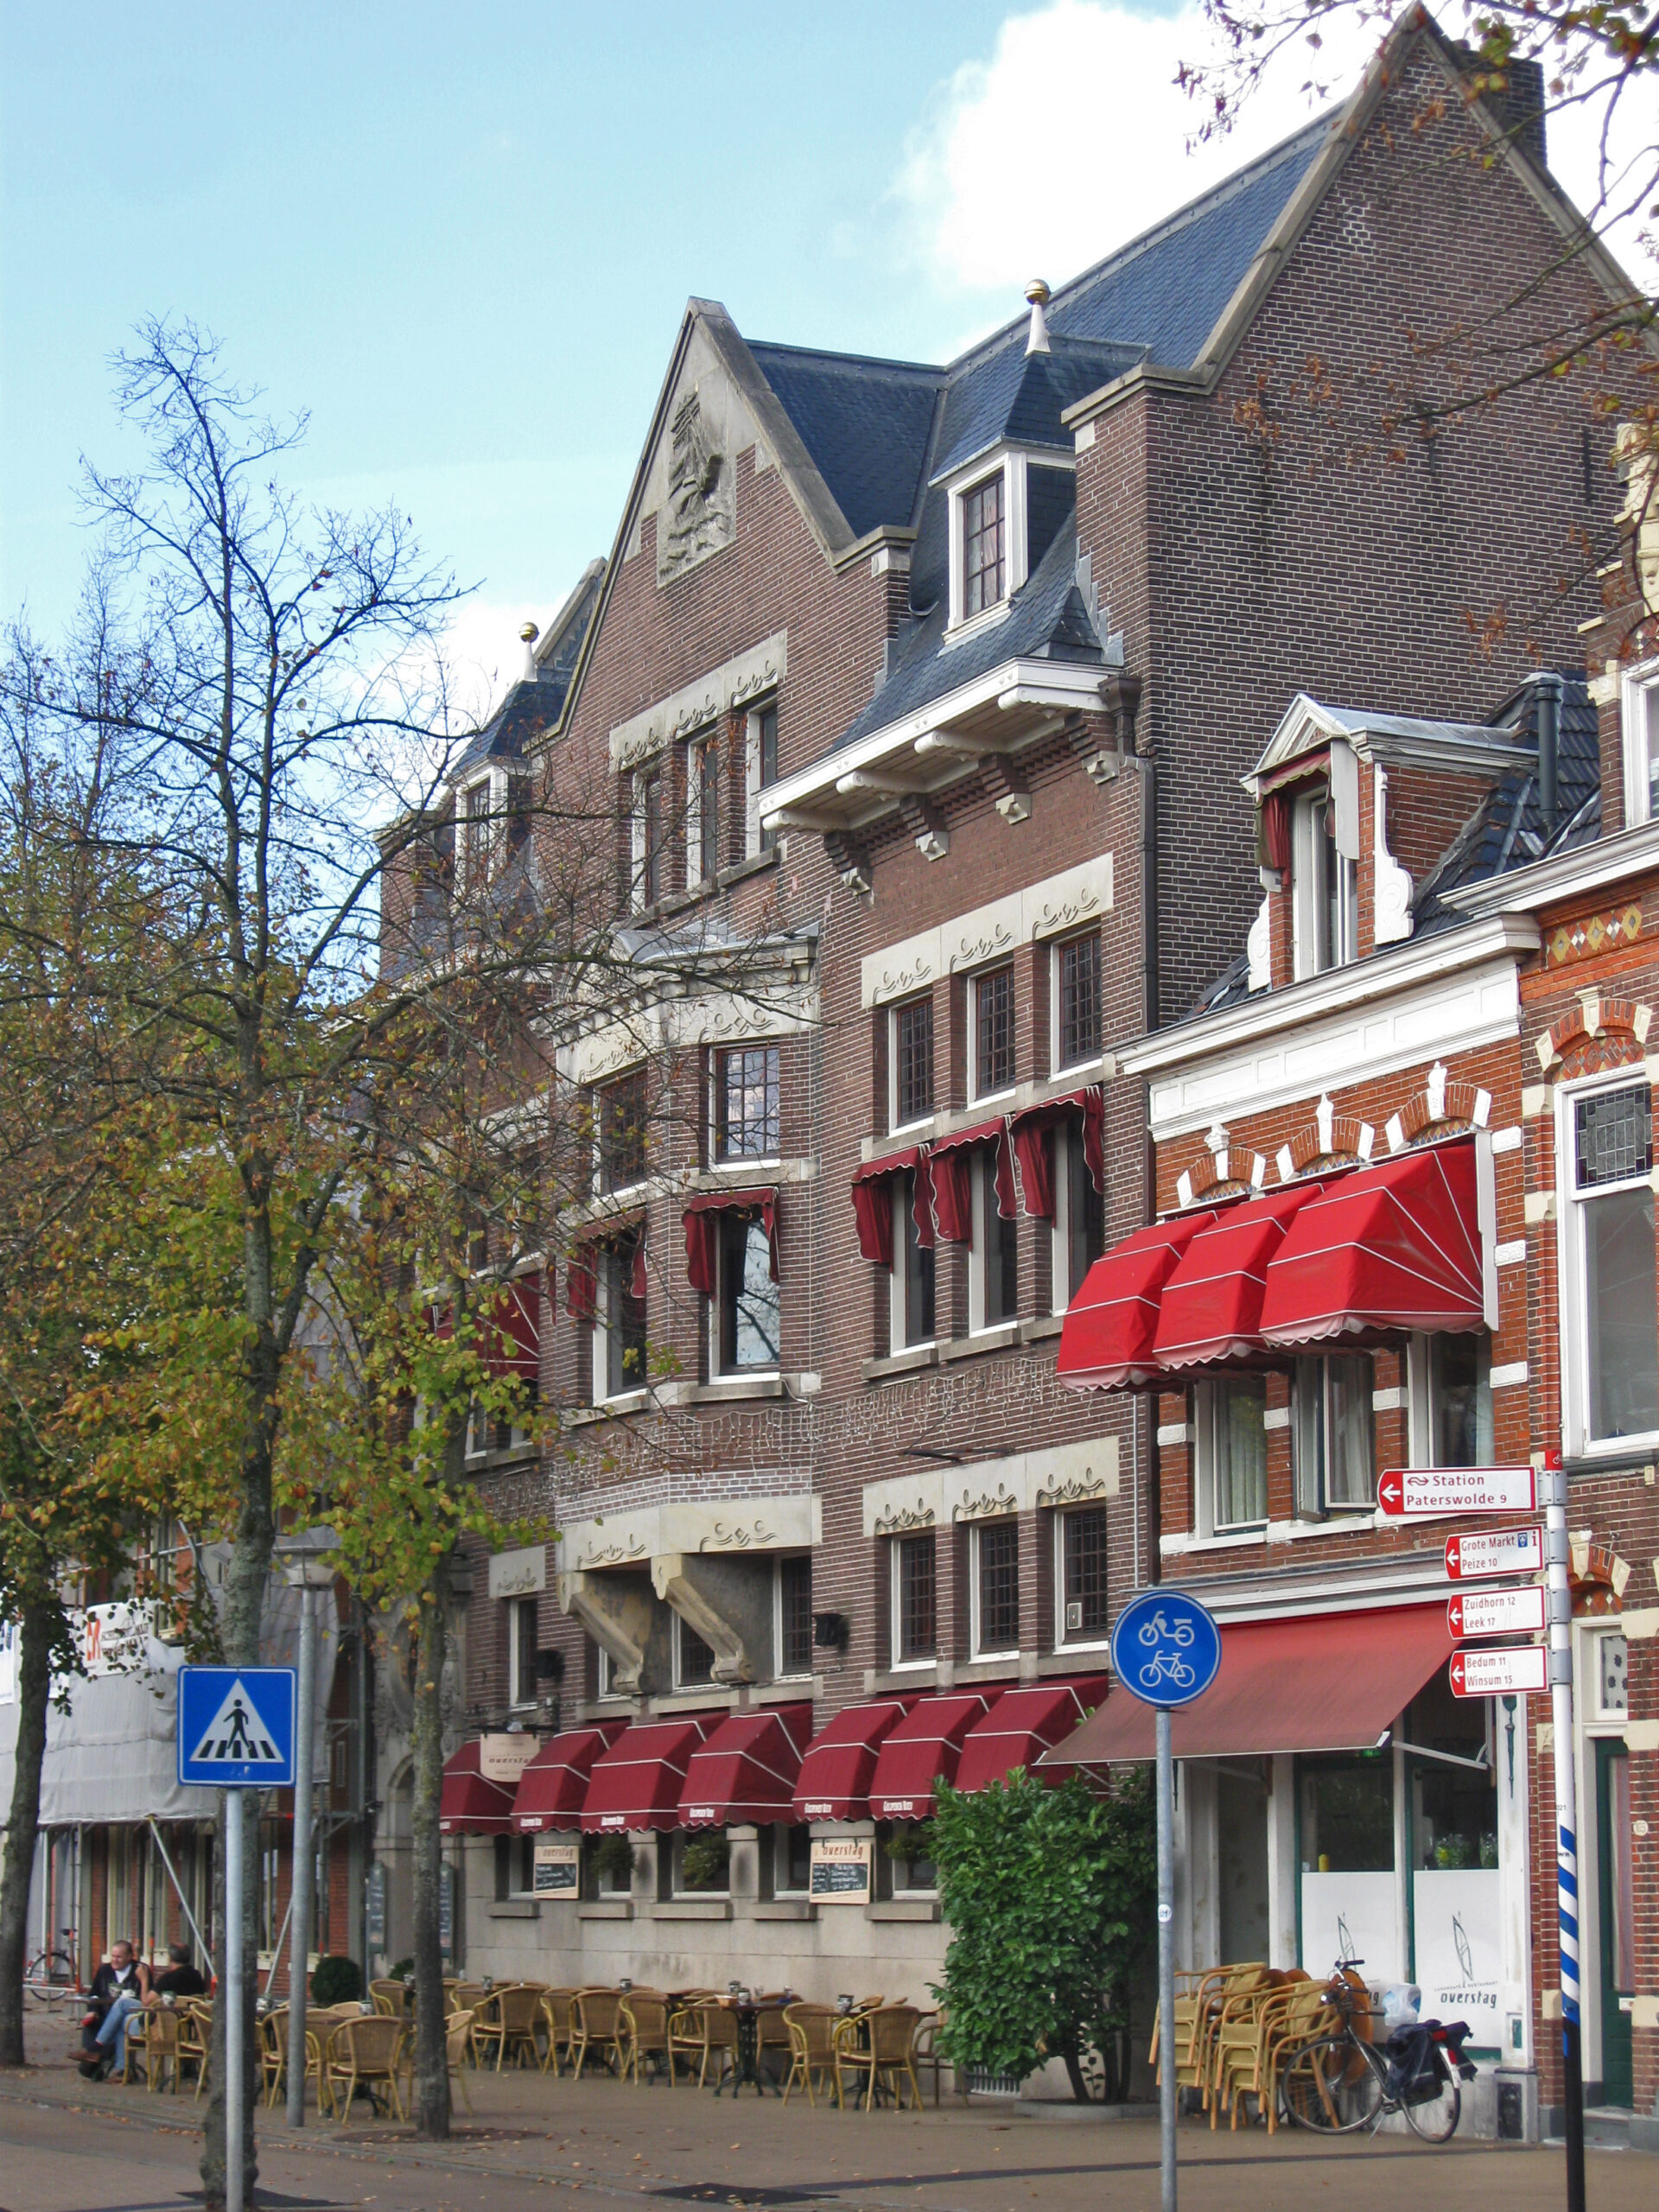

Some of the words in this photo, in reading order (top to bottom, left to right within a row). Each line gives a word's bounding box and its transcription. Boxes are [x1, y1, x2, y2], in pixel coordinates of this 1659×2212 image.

[1433, 1474, 1484, 1486] Station
[1407, 1493, 1495, 1506] Paterswolde
[1500, 1494, 1507, 1503] 9
[1461, 1540, 1486, 1551] Grote
[1489, 1535, 1515, 1548] Markt
[1462, 1558, 1486, 1570] Peize
[1488, 1558, 1497, 1567] 10
[1465, 1597, 1504, 1611] Zuidhorn
[1507, 1596, 1516, 1605] 12
[1465, 1616, 1485, 1629] Leek
[1487, 1617, 1496, 1626] 17
[1466, 1656, 1496, 1669] Bedum
[1498, 1656, 1506, 1666] 11
[1466, 1675, 1502, 1687] Winsum
[1504, 1675, 1513, 1685] 15
[823, 1844, 863, 1859] overstag
[1440, 1990, 1497, 2009] overstag
